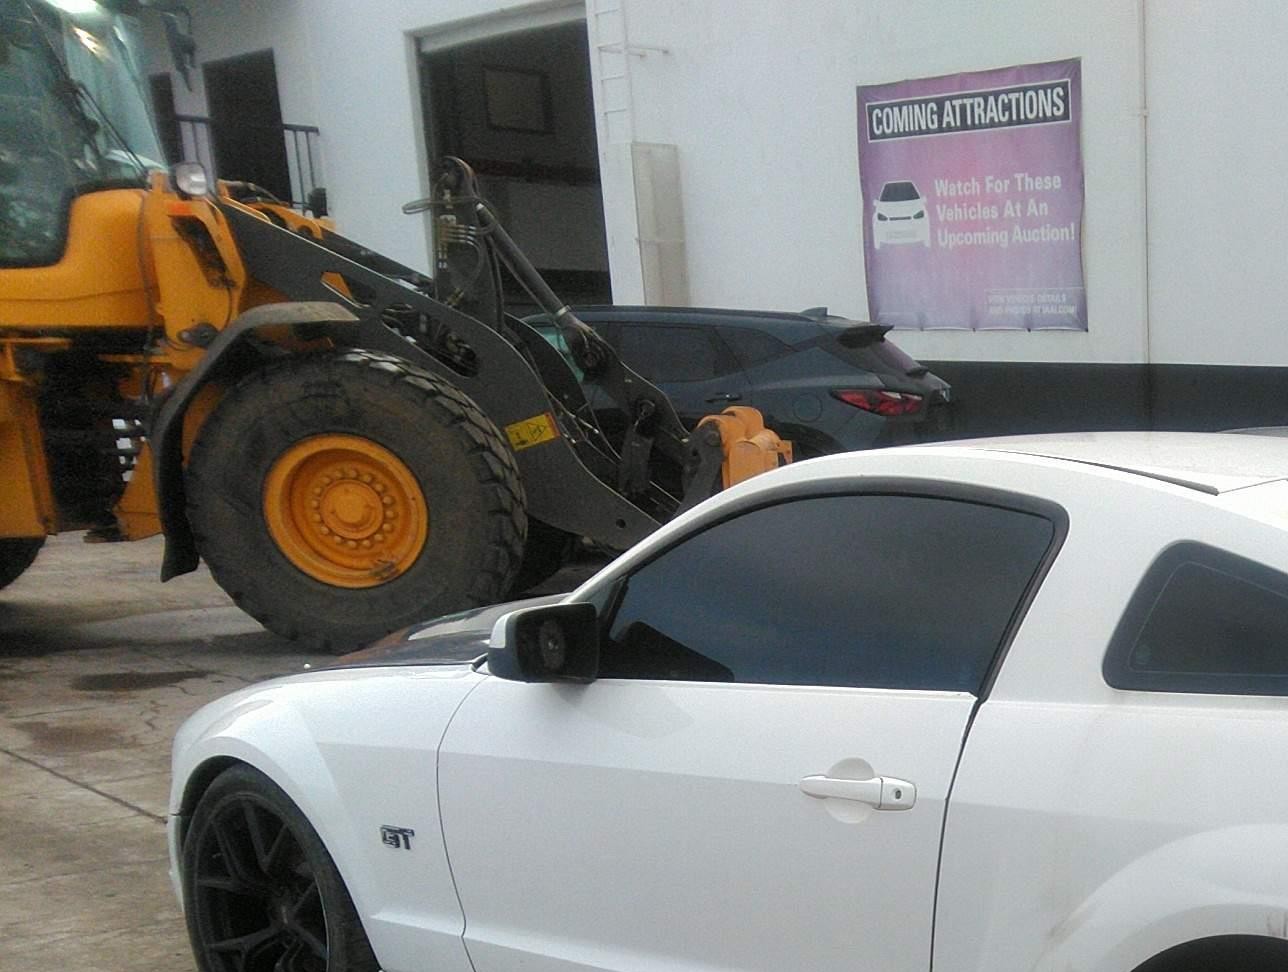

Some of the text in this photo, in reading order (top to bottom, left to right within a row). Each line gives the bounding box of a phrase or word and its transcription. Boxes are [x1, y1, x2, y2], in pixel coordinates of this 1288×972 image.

[872, 87, 1064, 136] COMING ATTRACTIONS
[934, 171, 1062, 197] Watch For These
[936, 199, 1049, 222] Vehicles At An
[937, 222, 1075, 249] Upcoming Auction!
[380, 824, 415, 850] GT
